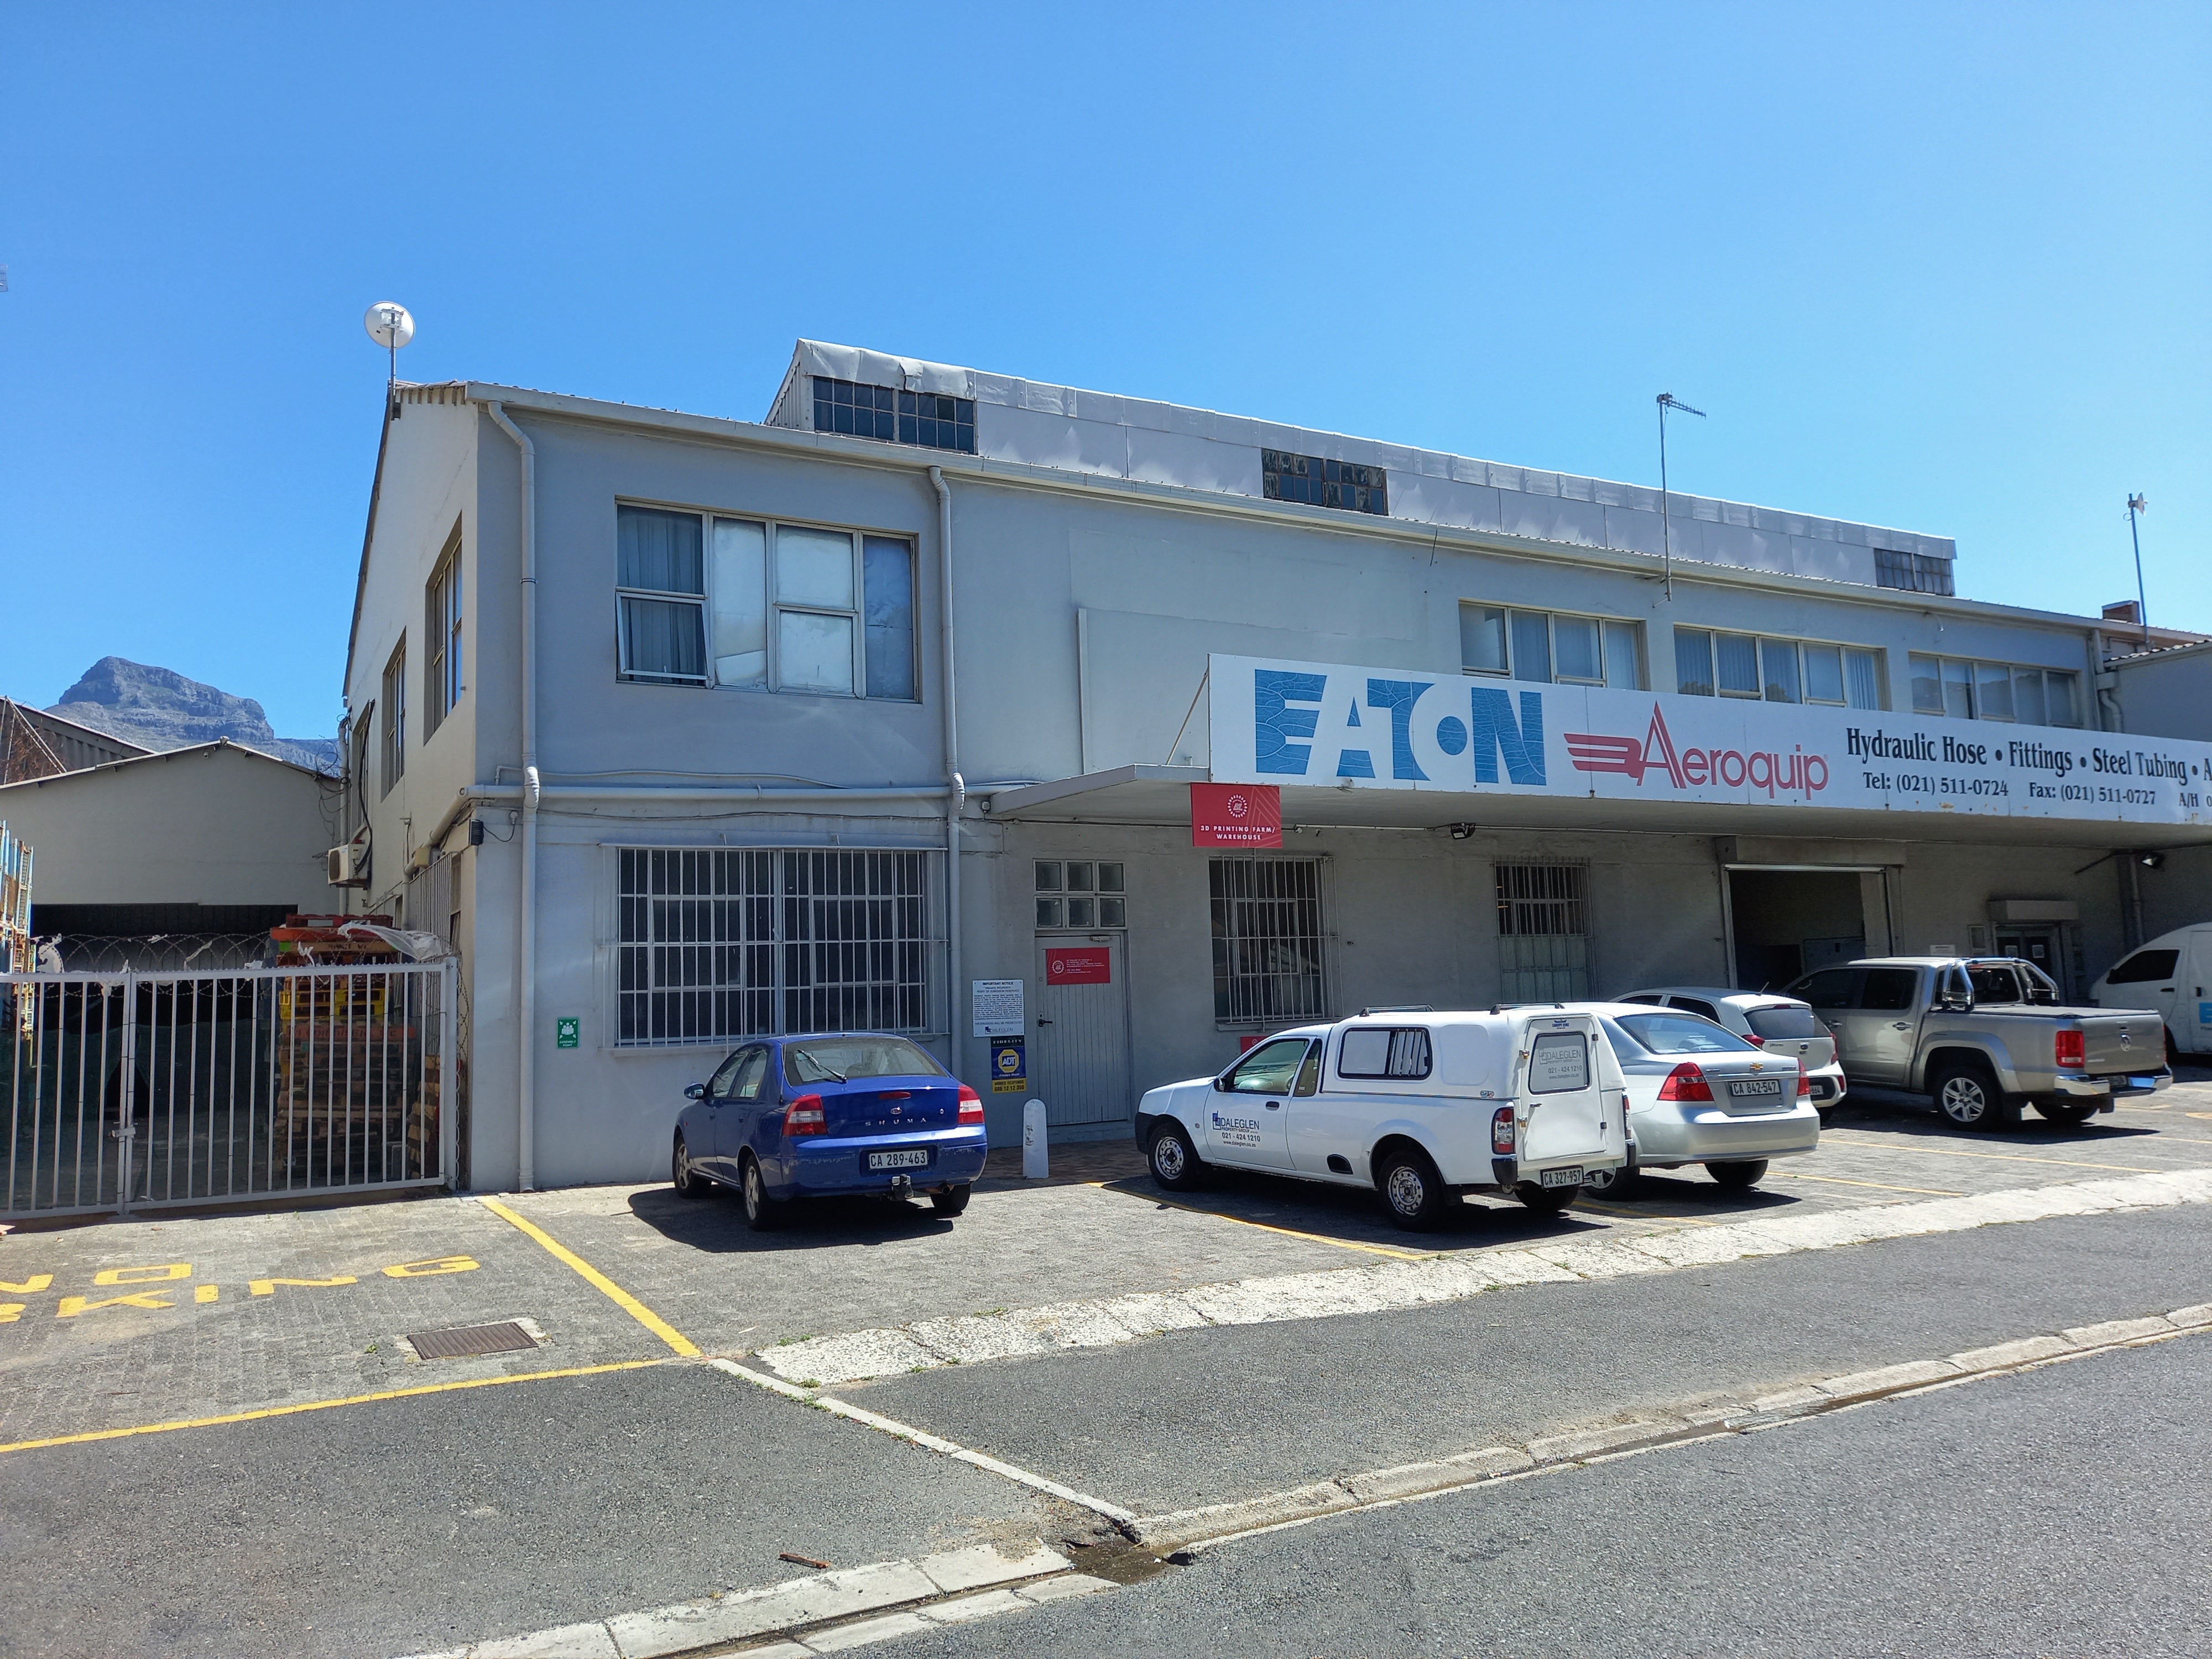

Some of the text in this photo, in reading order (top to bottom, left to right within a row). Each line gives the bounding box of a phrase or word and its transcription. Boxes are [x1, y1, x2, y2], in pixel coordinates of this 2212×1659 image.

[1255, 669, 1547, 786] EATON
[1637, 700, 1829, 801] Aeroquip
[1846, 727, 1937, 764] Hydraulic
[1942, 735, 1987, 765] Hose
[2008, 740, 2073, 778] Fittings
[2093, 747, 2133, 775] Steel
[2135, 752, 2188, 786] Tubing
[1863, 772, 1891, 790] Tel:
[1896, 774, 1936, 796] (021)
[1940, 777, 2008, 797] 511-0724
[2029, 782, 2056, 799] Fax:
[2060, 784, 2094, 804] (021)
[2099, 786, 2156, 805] 511-0727
[2179, 792, 2199, 808] A/H
[1002, 1057, 1016, 1066] ADT
[1547, 1049, 1582, 1060] DALEGLEN
[1733, 1082, 1776, 1094] CA 842-547
[865, 1118, 926, 1126] SHUMA
[1220, 1117, 1260, 1130] DALEGLEN
[870, 1152, 926, 1167] CA 289-463
[1544, 1170, 1581, 1186] CA 327-957
